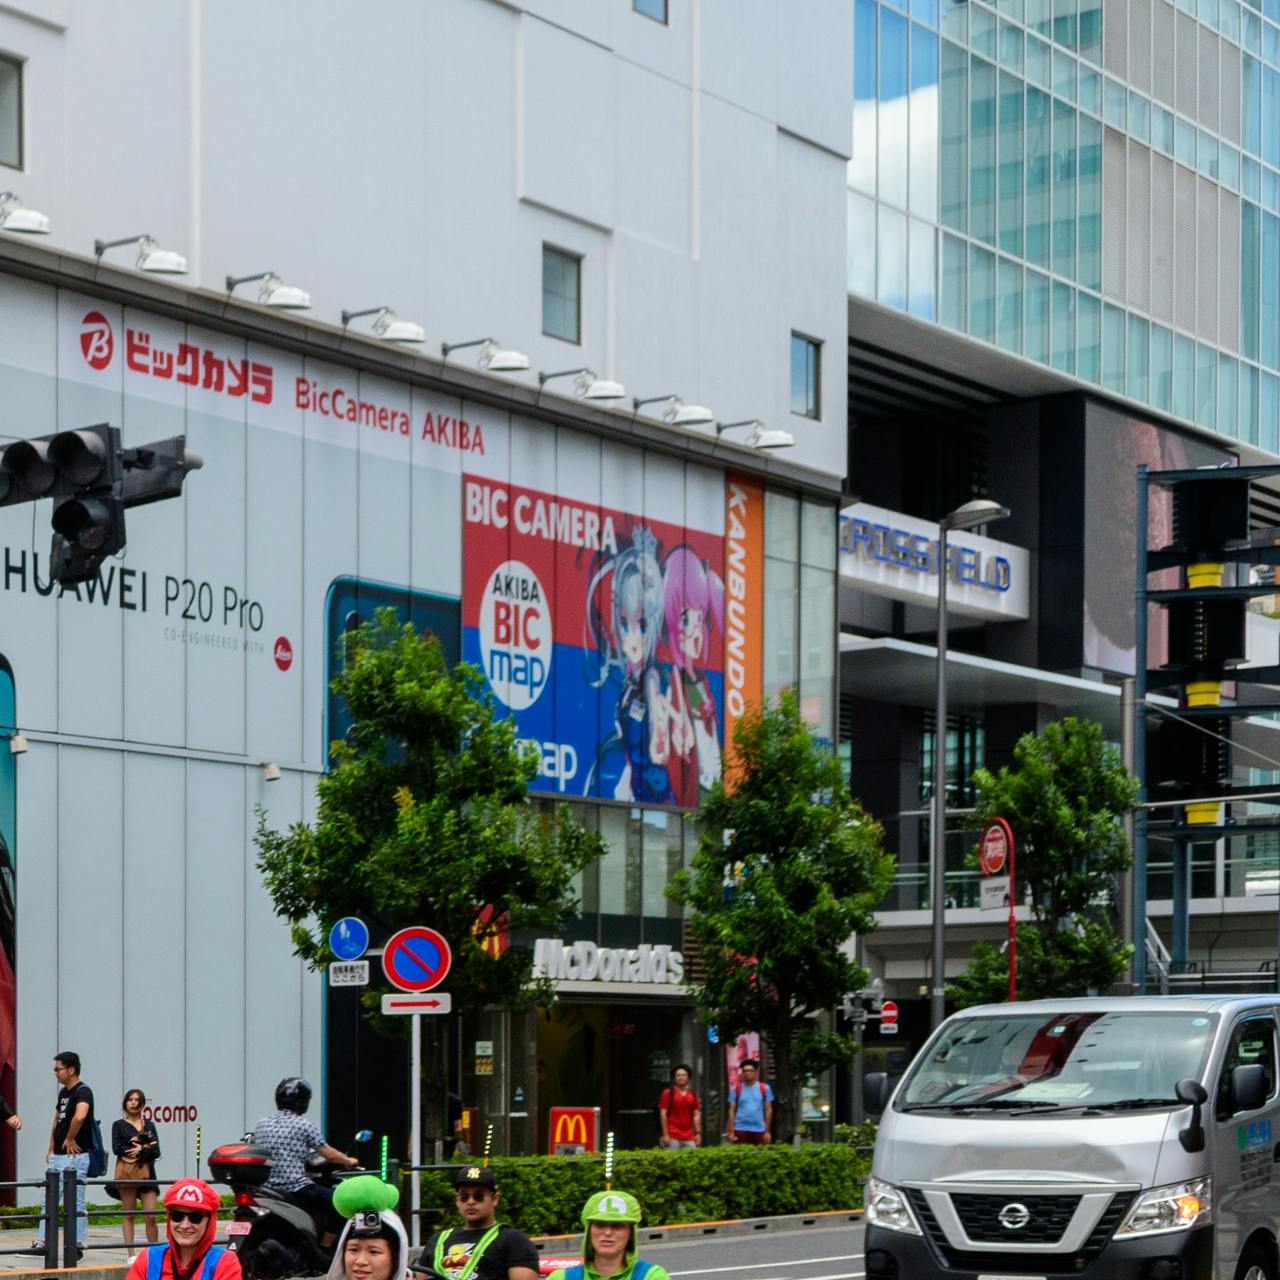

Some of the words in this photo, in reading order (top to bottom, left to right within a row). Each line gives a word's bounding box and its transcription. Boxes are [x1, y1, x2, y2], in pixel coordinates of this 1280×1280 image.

[125, 328, 274, 406] ビックカメラ
[295, 376, 411, 437] BicCamera
[421, 410, 486, 457] AKIBA
[465, 481, 509, 530] BIC
[512, 493, 618, 555] CAMERA
[164, 575, 214, 623] P20
[223, 585, 265, 632] Pro
[491, 571, 540, 605] AKIBA
[725, 480, 749, 719] KANBUNDO
[493, 602, 541, 651] BIC
[489, 648, 546, 699] map
[533, 937, 684, 985] McDonald's
